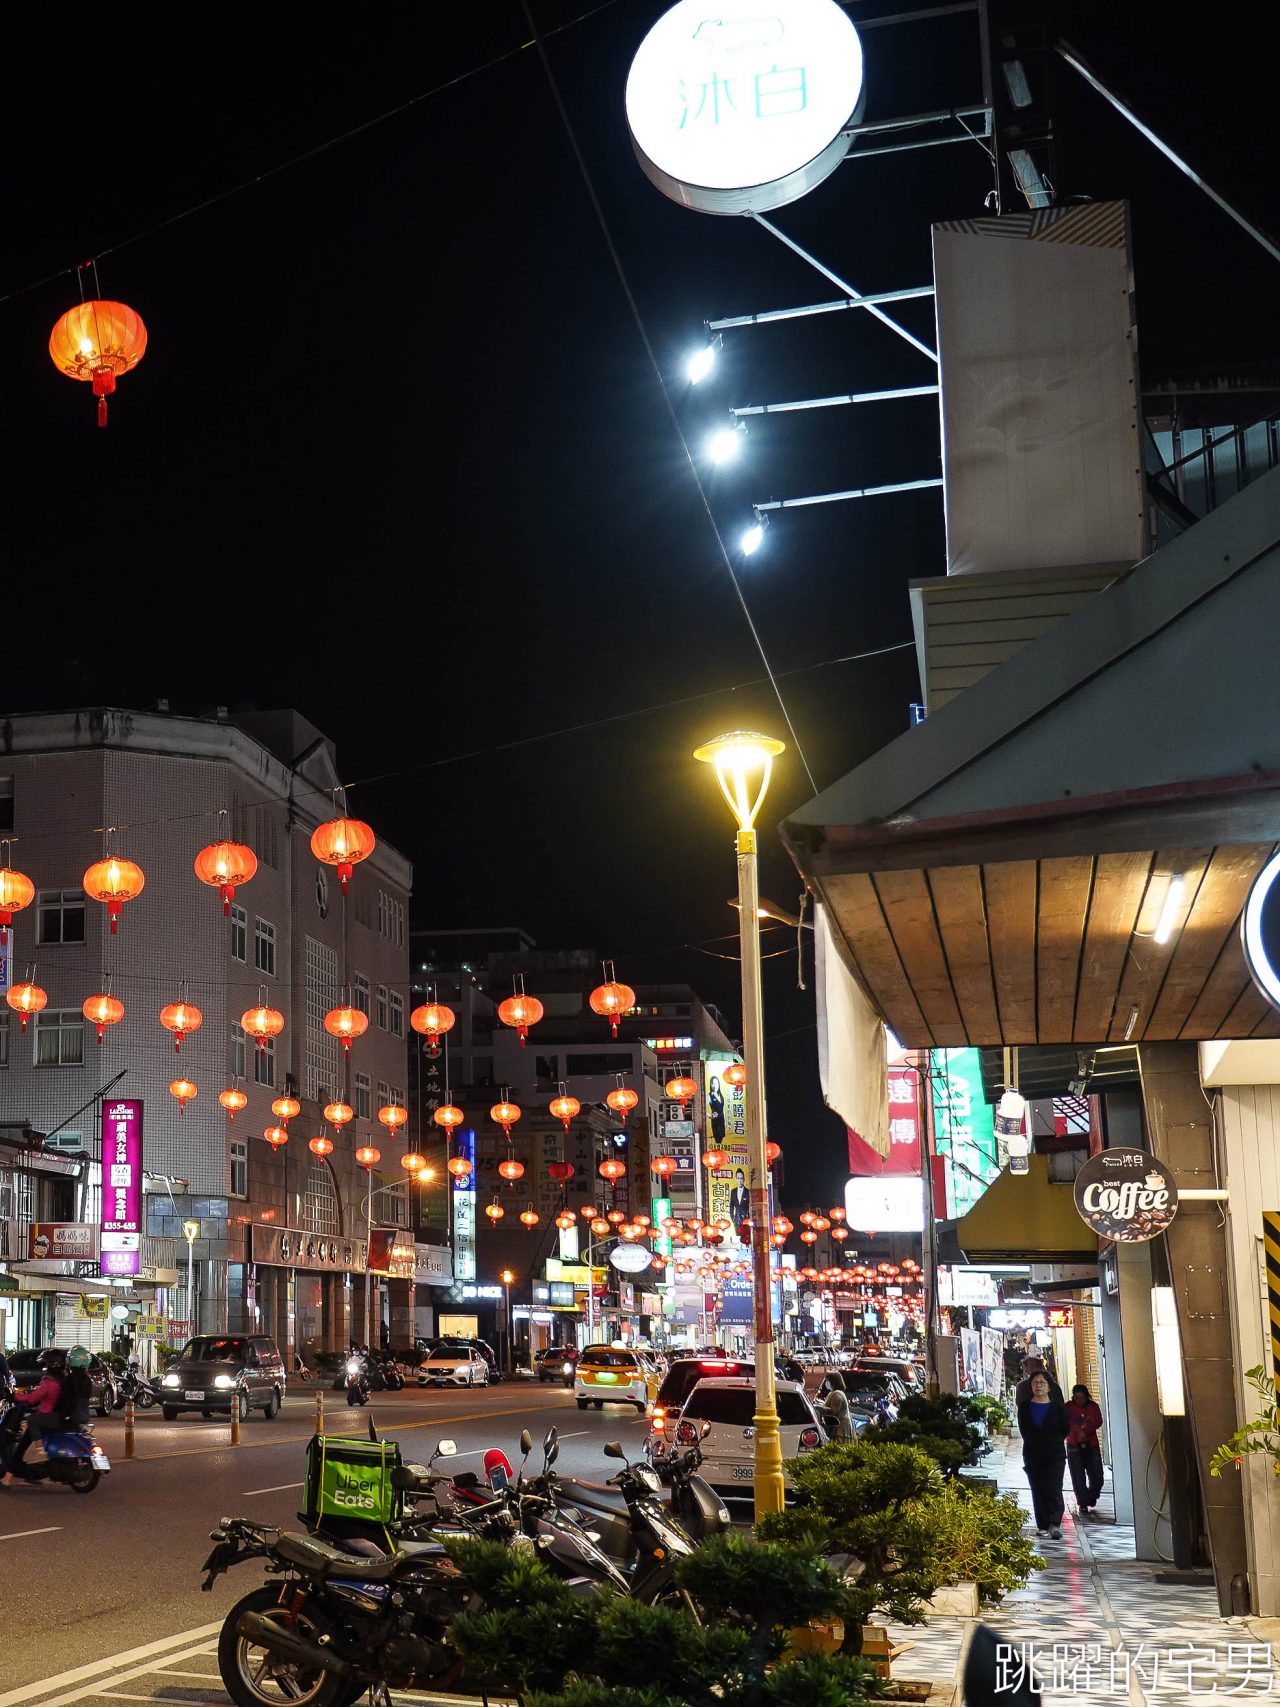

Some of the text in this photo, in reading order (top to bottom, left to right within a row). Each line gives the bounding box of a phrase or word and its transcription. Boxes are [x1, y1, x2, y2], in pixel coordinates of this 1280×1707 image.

[1083, 1182, 1169, 1219] Coffee
[336, 1472, 376, 1491] Uber
[333, 1490, 375, 1509] Eats
